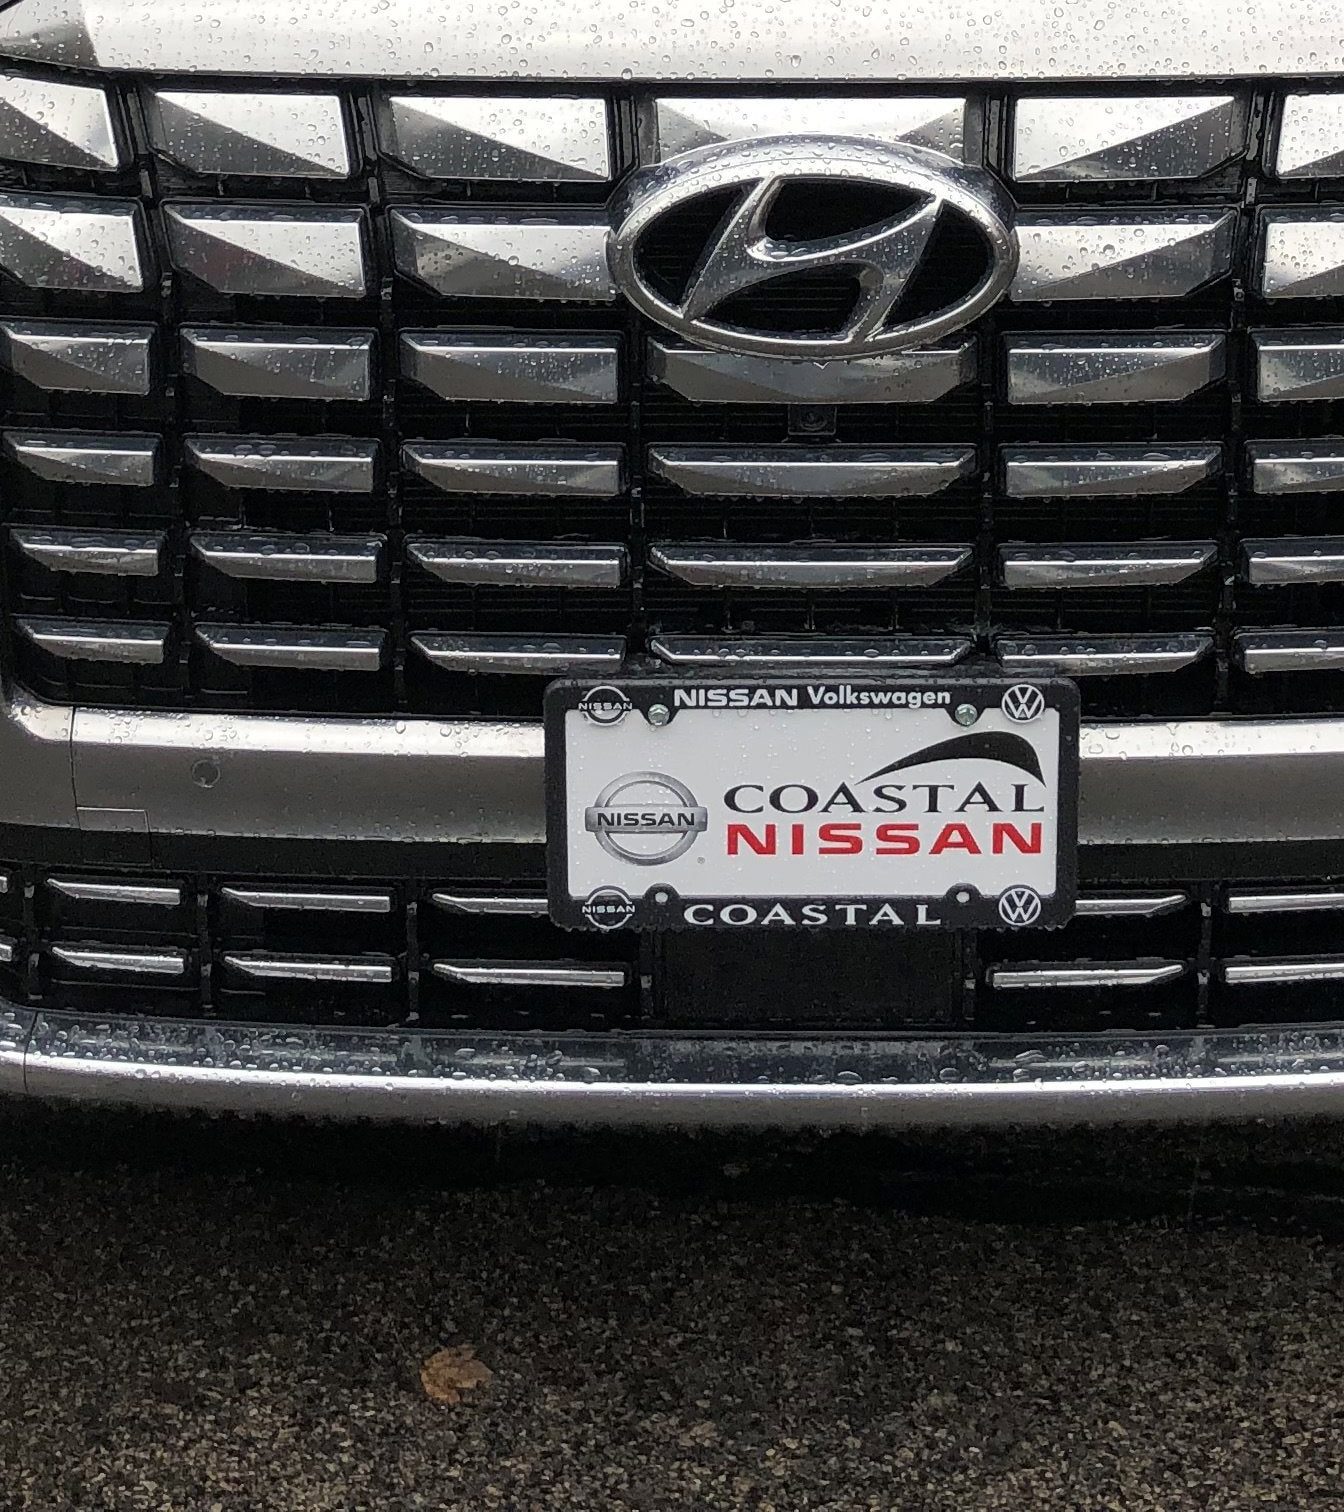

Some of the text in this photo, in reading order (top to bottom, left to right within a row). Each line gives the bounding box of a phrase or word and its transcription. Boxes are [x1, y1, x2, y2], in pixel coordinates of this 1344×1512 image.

[578, 701, 633, 711] NISSAN
[674, 685, 951, 709] NISSAN Volkswagen
[724, 781, 1045, 814] COASTAL
[597, 812, 695, 828] NISSAN
[727, 822, 1042, 855] NISSAN
[582, 905, 636, 914] NISSAN
[683, 903, 942, 925] COASTAL
